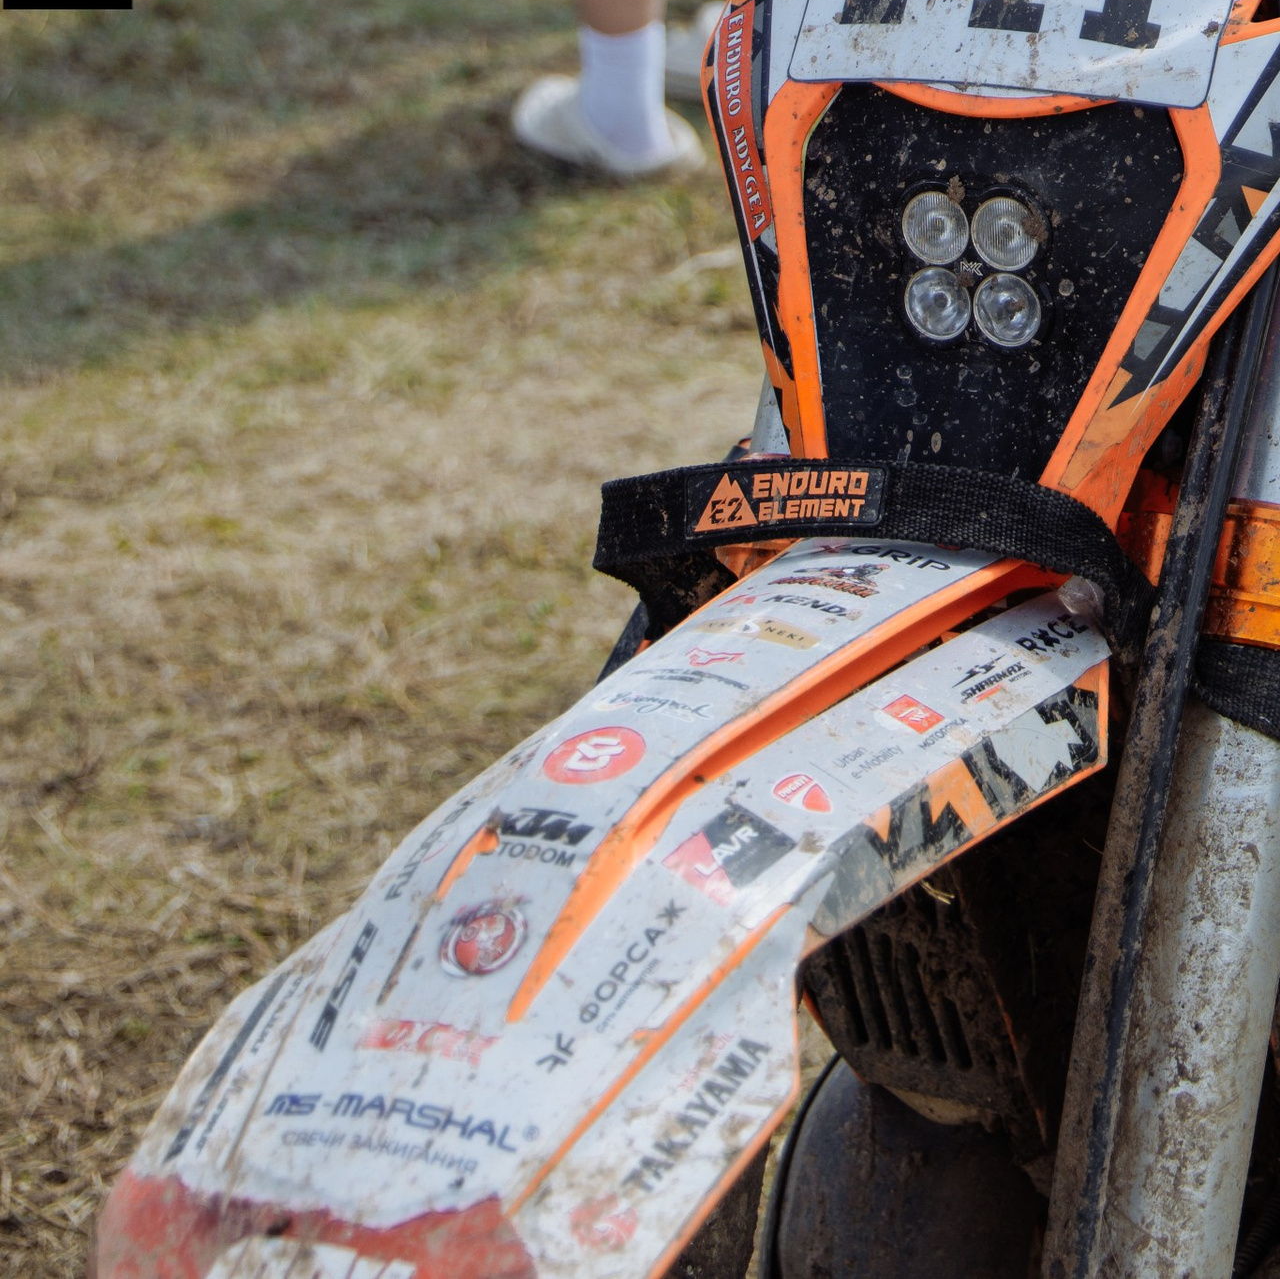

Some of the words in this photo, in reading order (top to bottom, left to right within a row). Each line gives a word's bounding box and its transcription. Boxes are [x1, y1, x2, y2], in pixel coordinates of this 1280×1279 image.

[717, 11, 745, 118] ENDURO
[731, 125, 767, 233] ADYGEA
[752, 470, 870, 499] ENDURO
[758, 498, 866, 522] ELEMENT
[832, 745, 868, 770] Urban
[850, 743, 904, 781] e-Mobility
[500, 807, 595, 847] KTM
[497, 839, 577, 869] TODOM
[693, 825, 760, 877] LAVR
[578, 898, 688, 1025] ФОРСАЖ
[264, 1093, 518, 1154] MS-MARSHAL
[621, 1037, 771, 1193] TAKAYAMA
[281, 1129, 346, 1148] СВЕЧИ
[352, 1131, 479, 1174] ЗАЖИГАНИЯ
